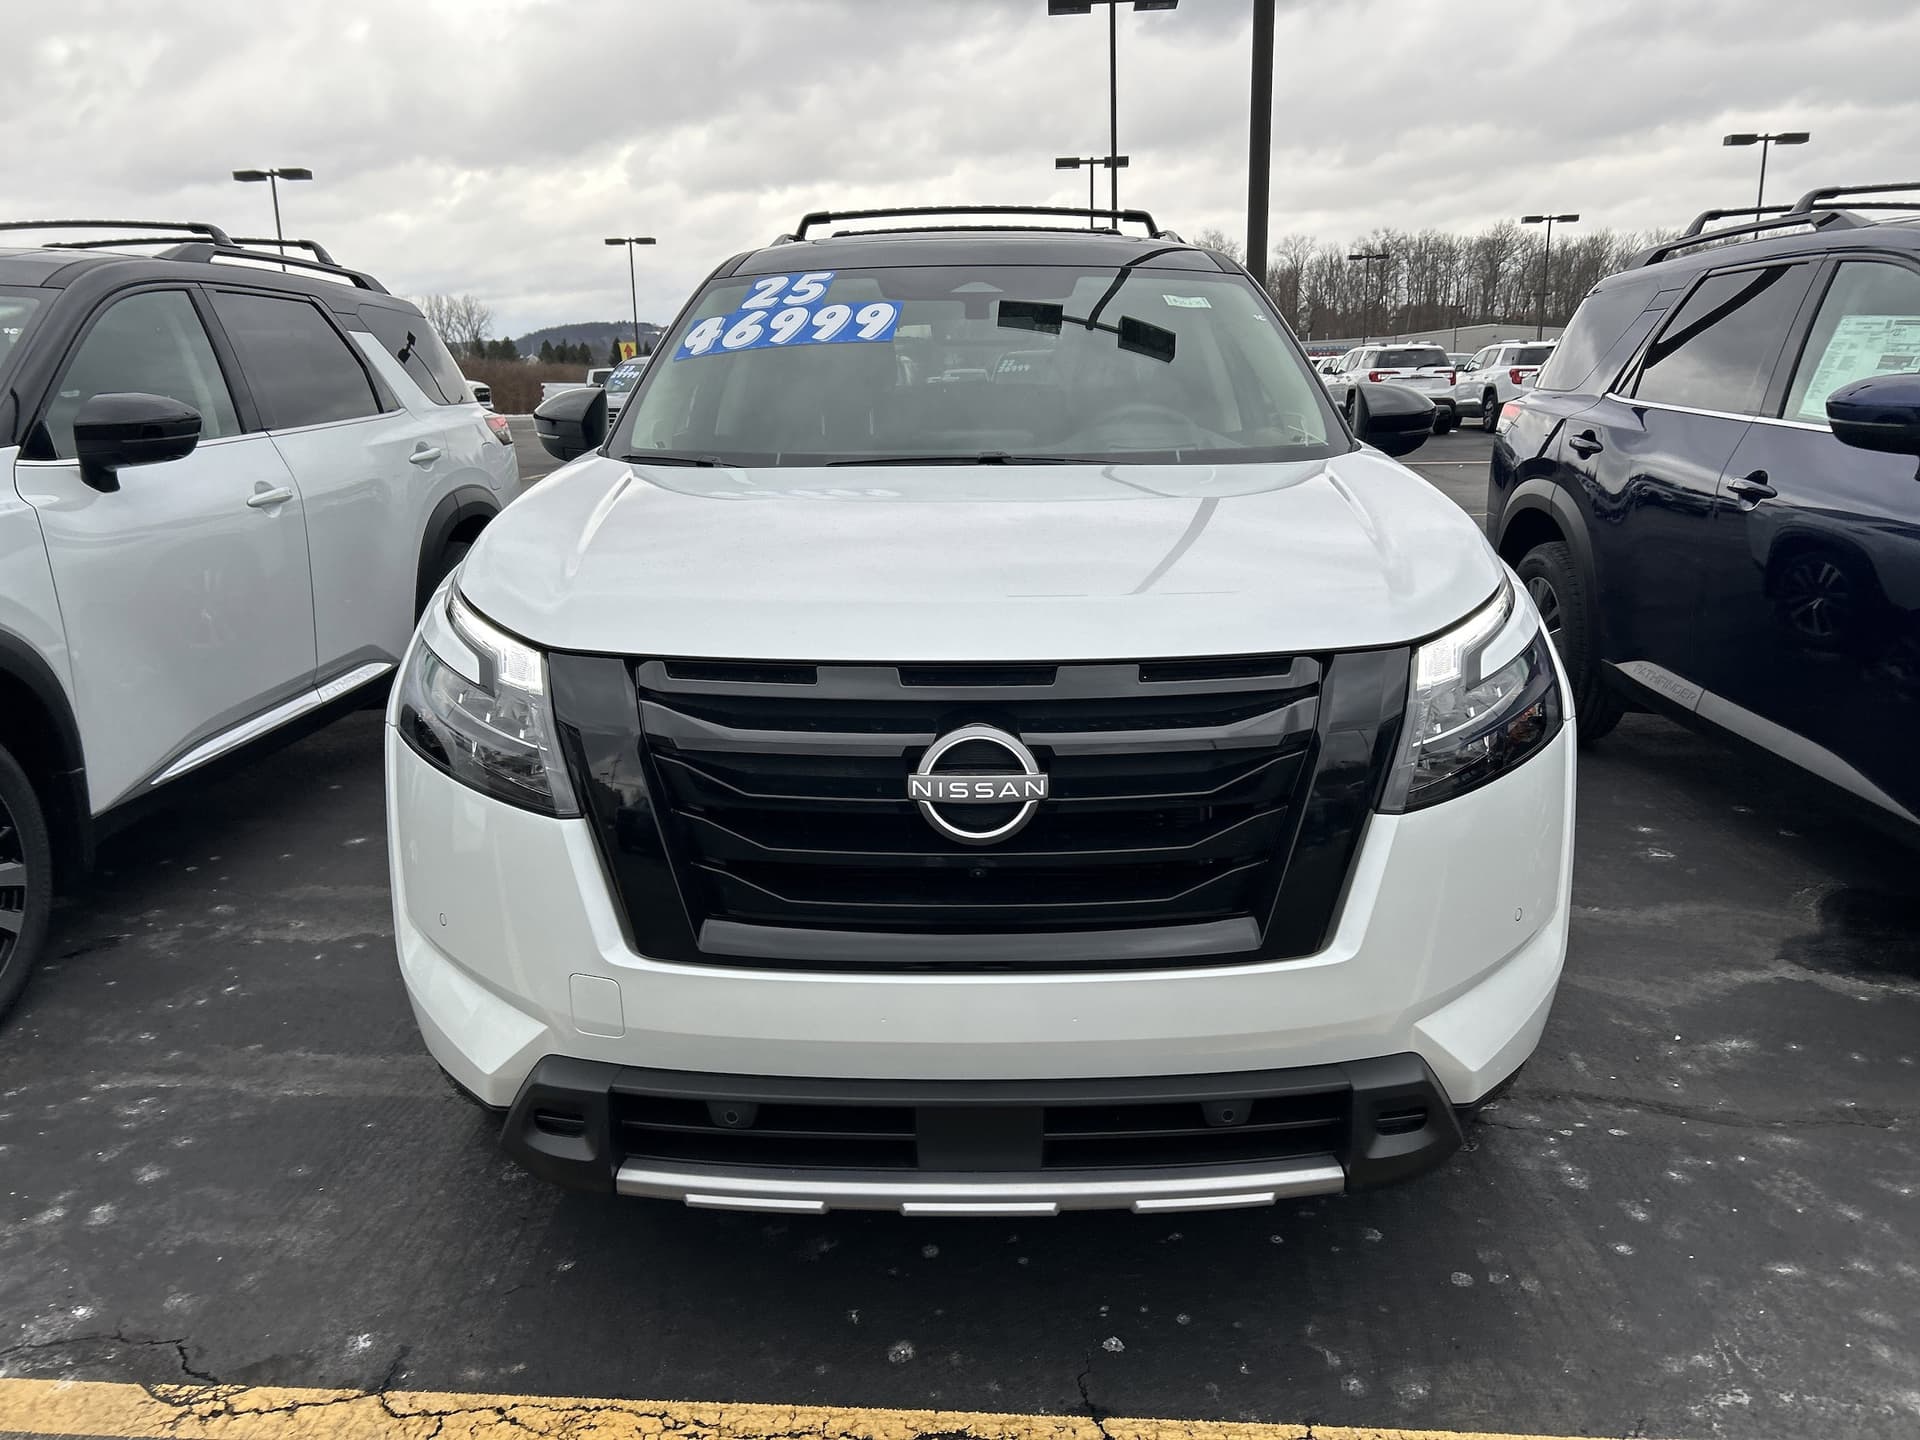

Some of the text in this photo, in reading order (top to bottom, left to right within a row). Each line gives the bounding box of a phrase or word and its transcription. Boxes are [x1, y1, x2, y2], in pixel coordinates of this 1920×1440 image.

[742, 272, 834, 309] 25
[684, 303, 897, 356] 46999
[911, 780, 1045, 798] NISSAN
